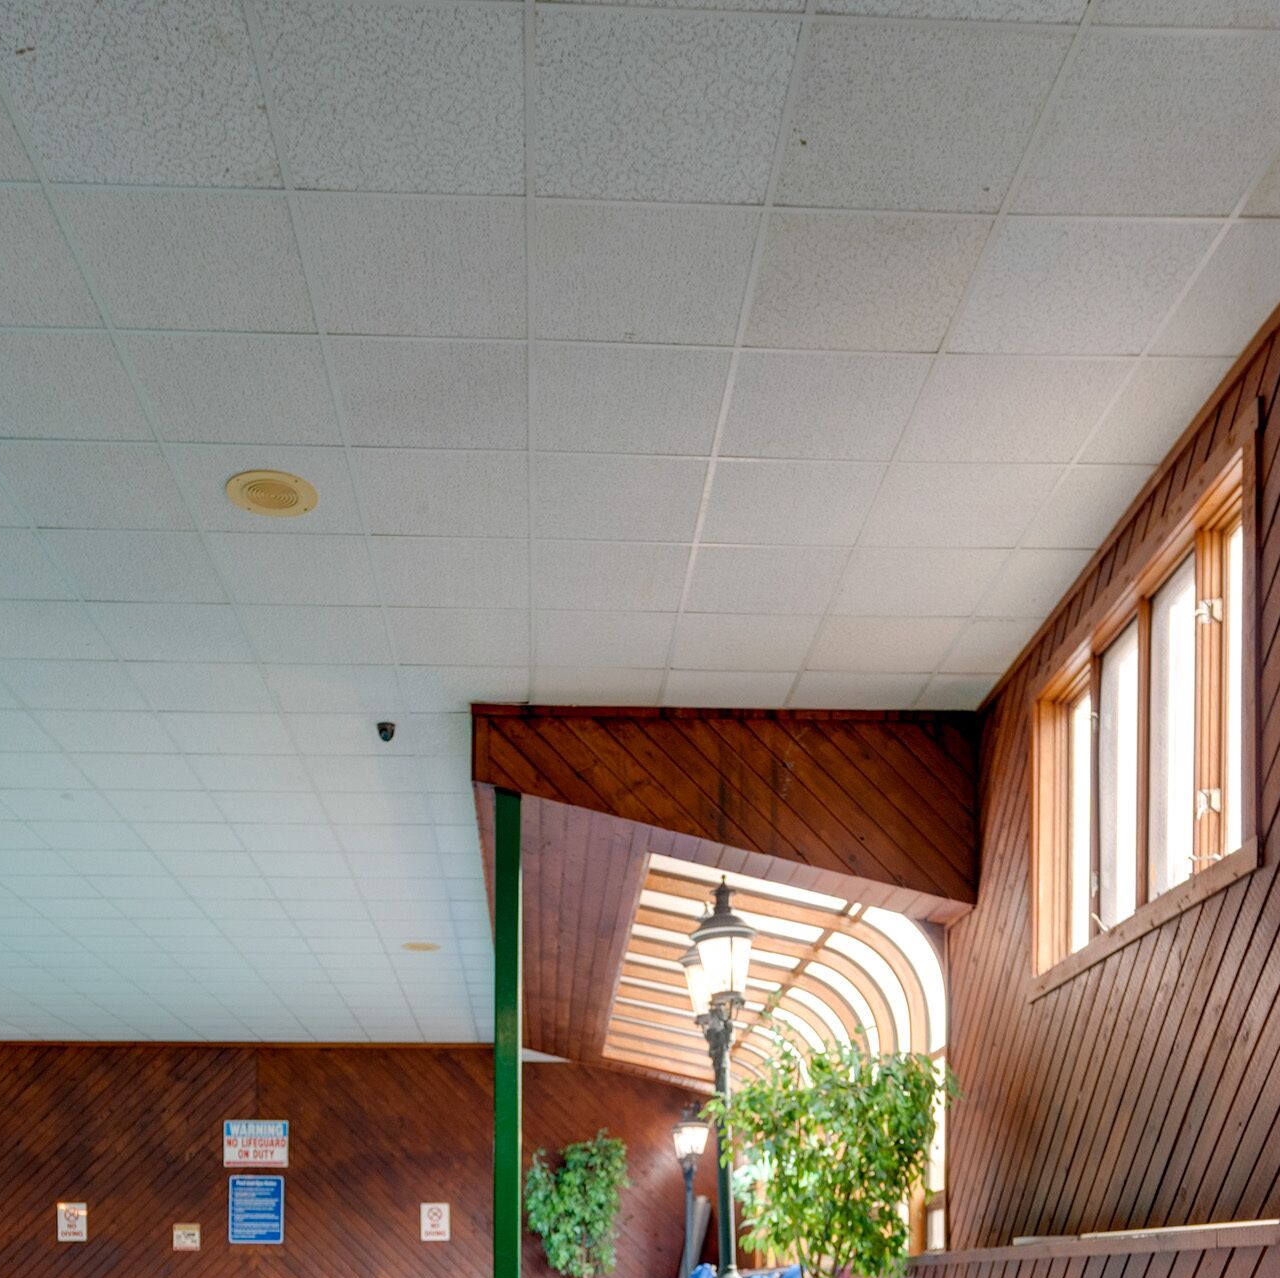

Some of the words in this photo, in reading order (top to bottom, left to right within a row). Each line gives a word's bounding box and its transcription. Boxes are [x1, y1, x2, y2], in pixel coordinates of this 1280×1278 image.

[230, 1122, 283, 1137] WARNING
[227, 1138, 238, 1147] NO
[241, 1138, 286, 1147] LIFEGUARD
[238, 1150, 249, 1159] ON
[253, 1150, 274, 1159] DUTY
